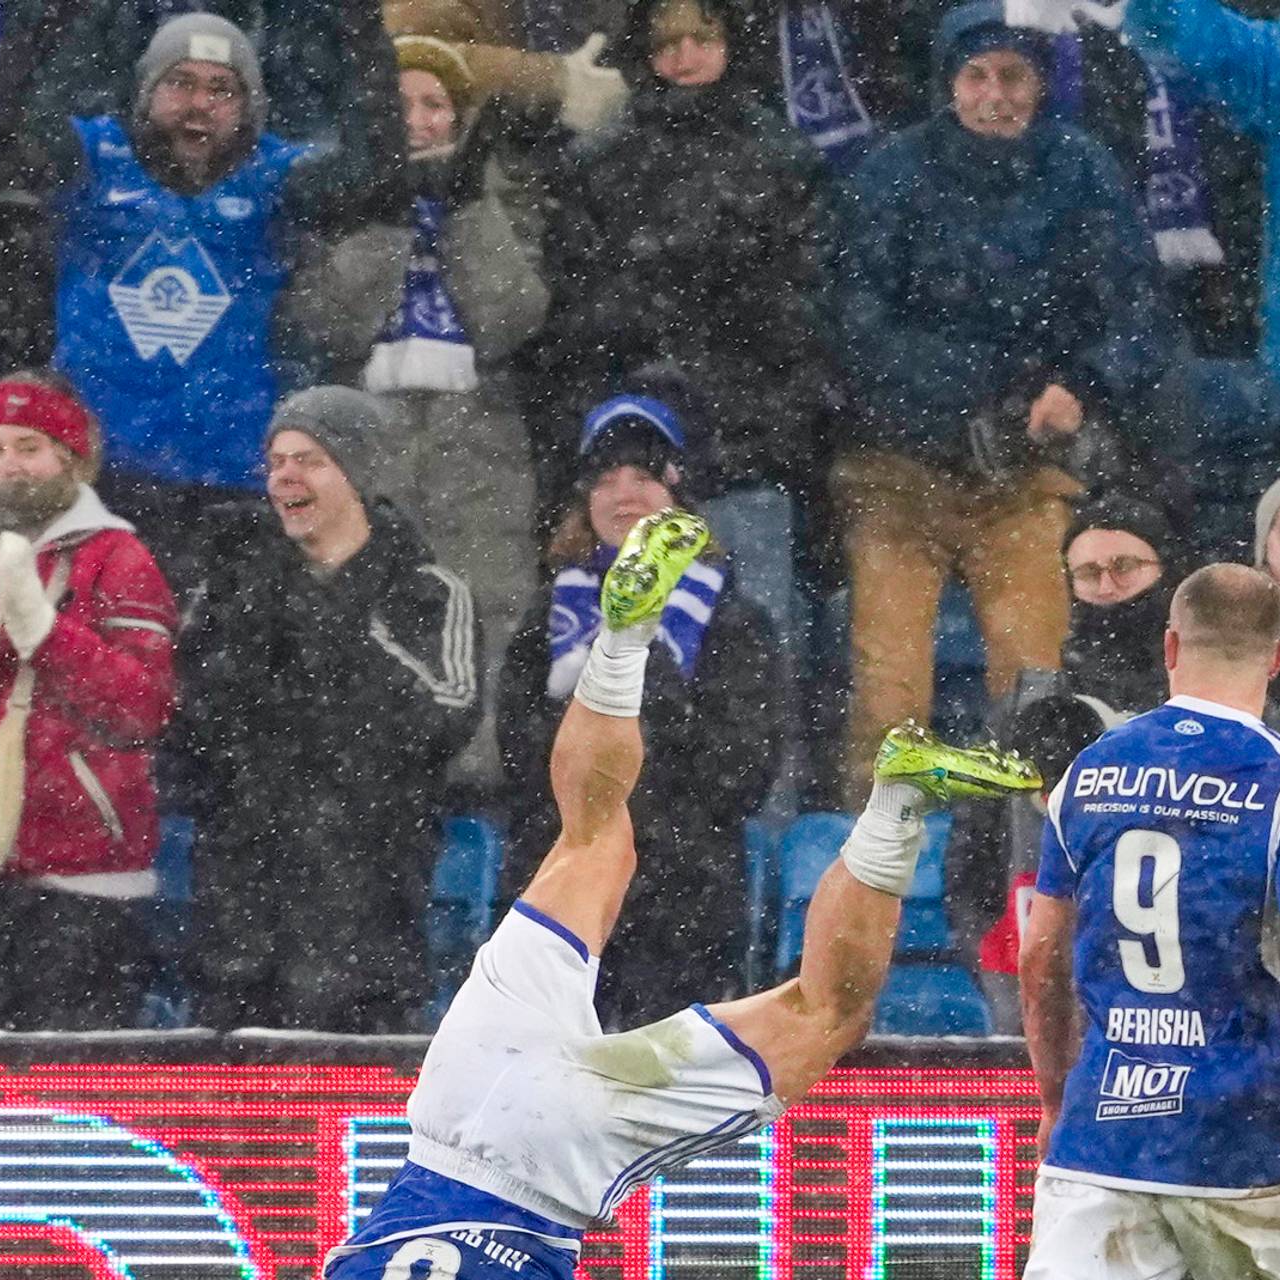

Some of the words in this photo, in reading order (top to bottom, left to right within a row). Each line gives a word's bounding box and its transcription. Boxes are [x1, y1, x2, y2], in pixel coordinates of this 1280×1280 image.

[1073, 766, 1265, 810] BRUNVOLL
[1083, 803, 1137, 815] PRECISION
[1139, 804, 1150, 814] IS
[1154, 805, 1180, 818] OUR
[1184, 808, 1239, 825] PASSION
[1113, 828, 1184, 994] 9
[1106, 1007, 1206, 1047] BERISHA
[1111, 1064, 1190, 1098] MOT
[1102, 1105, 1129, 1117] SHOW
[1131, 1101, 1177, 1114] COURAGE!
